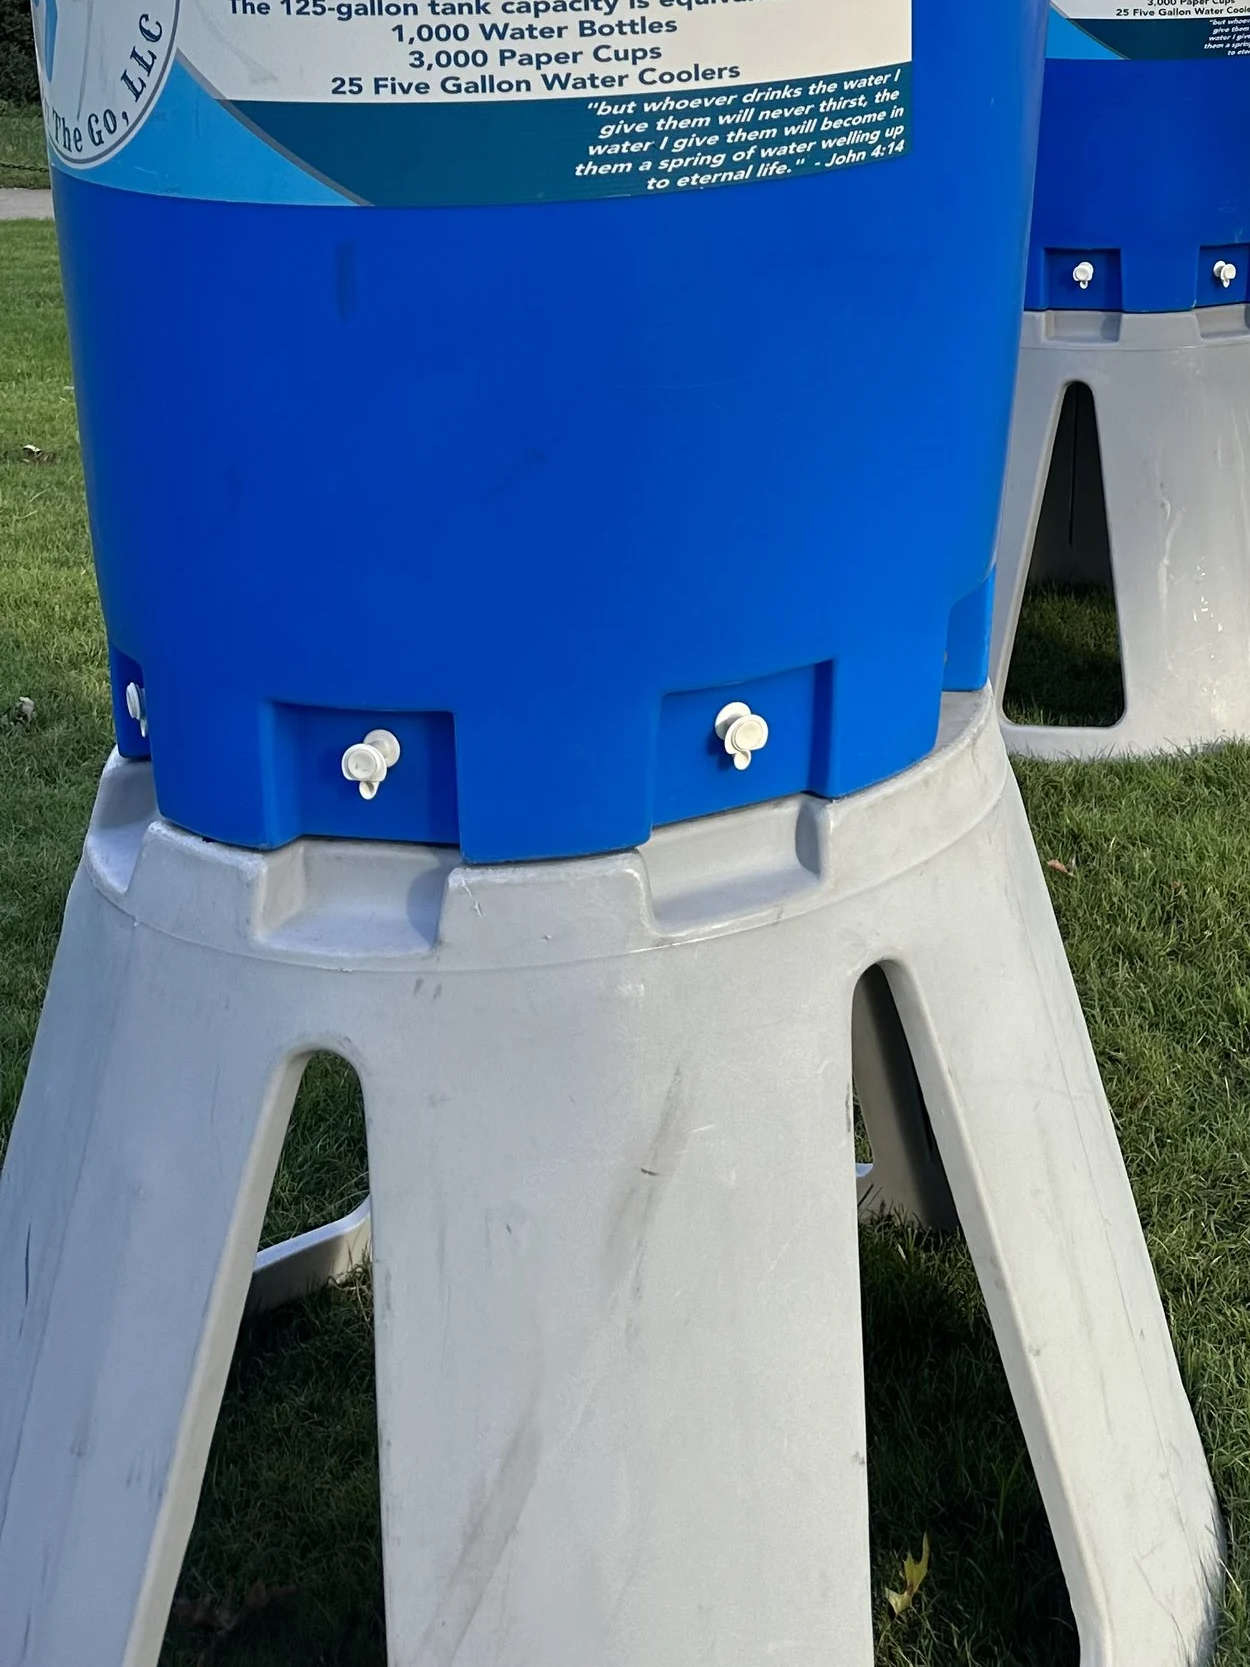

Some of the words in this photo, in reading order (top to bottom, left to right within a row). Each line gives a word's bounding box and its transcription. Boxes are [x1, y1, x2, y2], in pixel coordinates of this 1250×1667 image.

[391, 24, 470, 46] 1,000
[479, 21, 568, 41] Water
[579, 16, 678, 37] Bottles
[1116, 9, 1129, 17] 25
[1133, 8, 1155, 17] Five
[1158, 8, 1192, 17] Gallon
[1193, 7, 1224, 16] Water
[408, 49, 488, 71] 3,000
[499, 47, 583, 71] Paper
[592, 41, 662, 66] Cups
[52, 105, 83, 153] The
[120, 13, 163, 102] LLC
[331, 77, 364, 94] 25
[373, 76, 431, 95] Five
[440, 73, 531, 94] Gallon
[541, 72, 629, 92] Water
[638, 63, 741, 87] Coolers
[643, 93, 737, 112] whoever
[742, 85, 803, 105] drinks
[808, 80, 838, 95] the
[843, 72, 893, 91] water
[588, 139, 655, 156] water
[659, 137, 668, 151] I
[672, 133, 718, 153] give
[726, 127, 778, 143] them
[783, 119, 818, 135] will
[820, 110, 885, 131] become
[890, 105, 904, 119] in
[598, 120, 649, 139] give
[655, 114, 711, 131] them
[717, 108, 755, 125] will
[758, 103, 815, 121] never
[818, 95, 868, 114] thirst,
[874, 88, 900, 103] the
[574, 161, 633, 176] them
[638, 160, 652, 171] a
[657, 151, 726, 173] spring
[732, 146, 757, 162] of
[759, 140, 816, 158] water
[820, 126, 881, 150] welling
[884, 124, 905, 140] up
[647, 177, 670, 190] to
[676, 165, 754, 186] eternal
[824, 150, 867, 169] John
[871, 139, 906, 158] 4:14
